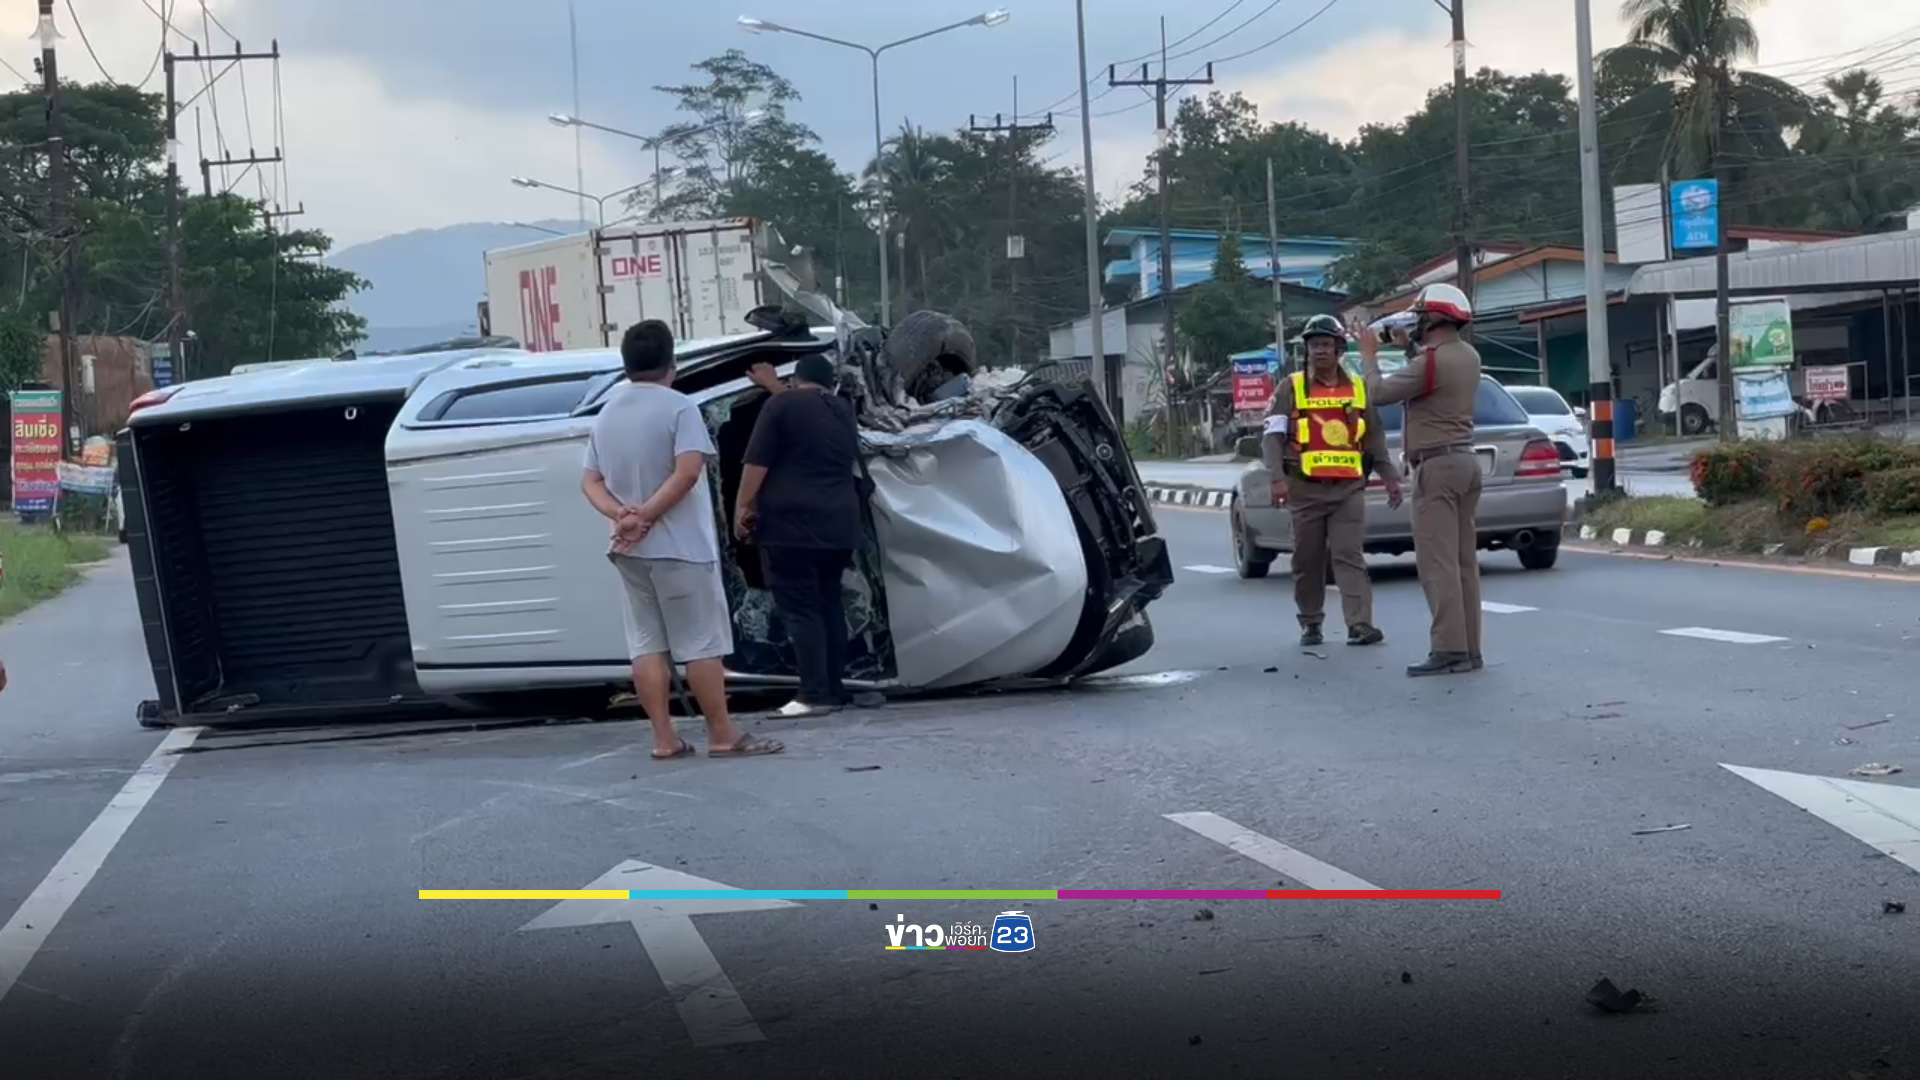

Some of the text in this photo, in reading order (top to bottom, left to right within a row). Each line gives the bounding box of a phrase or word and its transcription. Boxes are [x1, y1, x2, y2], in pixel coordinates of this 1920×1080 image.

[612, 254, 661, 276] ONE
[519, 265, 562, 352] ONE
[15, 413, 58, 438] สินเชื่อ
